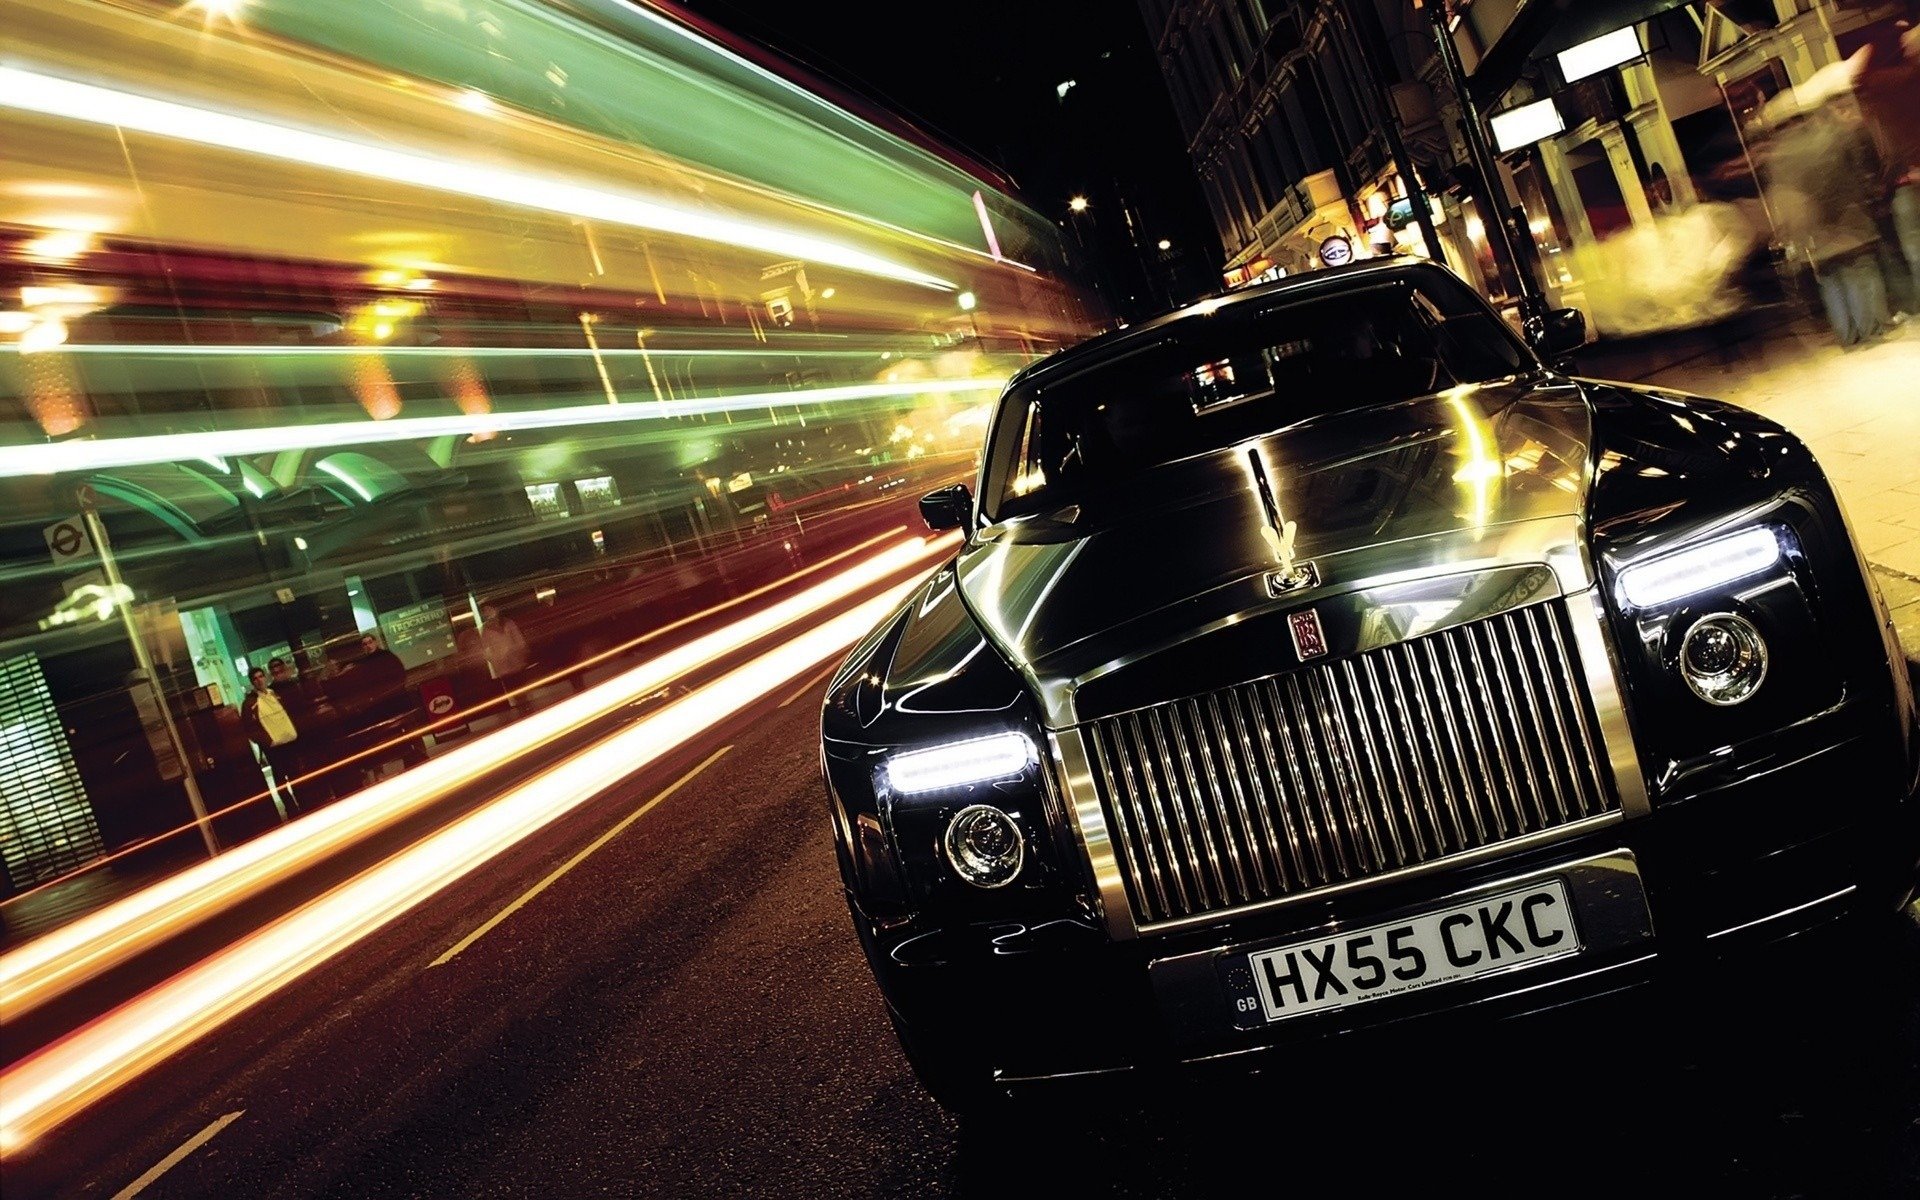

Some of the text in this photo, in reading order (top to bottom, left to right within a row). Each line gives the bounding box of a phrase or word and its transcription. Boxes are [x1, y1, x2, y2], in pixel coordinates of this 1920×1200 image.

[1261, 892, 1564, 1009] HX55 CKC
[1421, 977, 1442, 987] Limited
[1236, 996, 1257, 1012] GB
